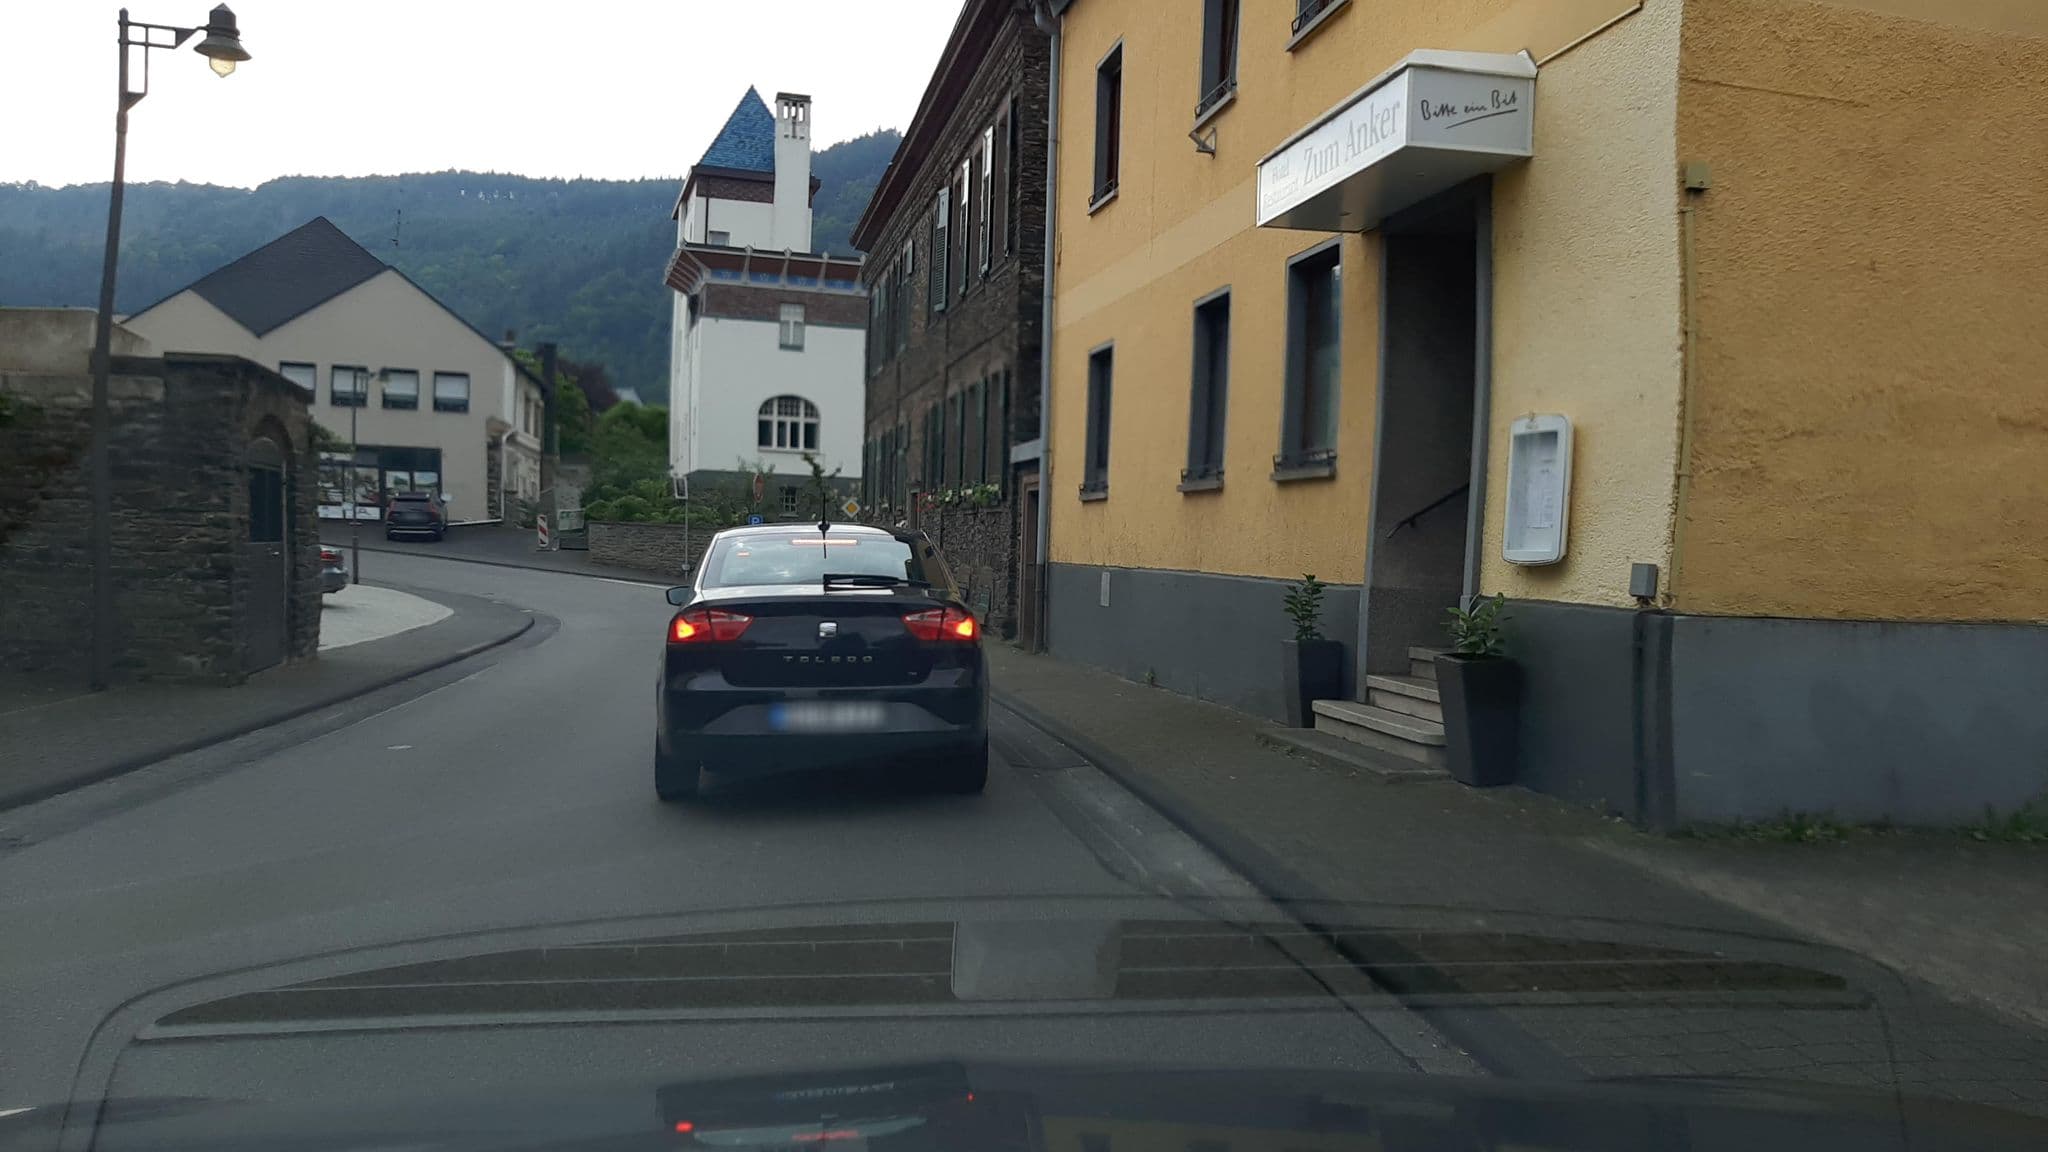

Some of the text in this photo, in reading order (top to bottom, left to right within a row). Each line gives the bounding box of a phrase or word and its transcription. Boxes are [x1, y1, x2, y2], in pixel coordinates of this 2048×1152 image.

[1420, 89, 1518, 121] Bitte ein Bit
[1303, 102, 1400, 184] Zum Anker
[783, 655, 873, 664] TOLEDO
